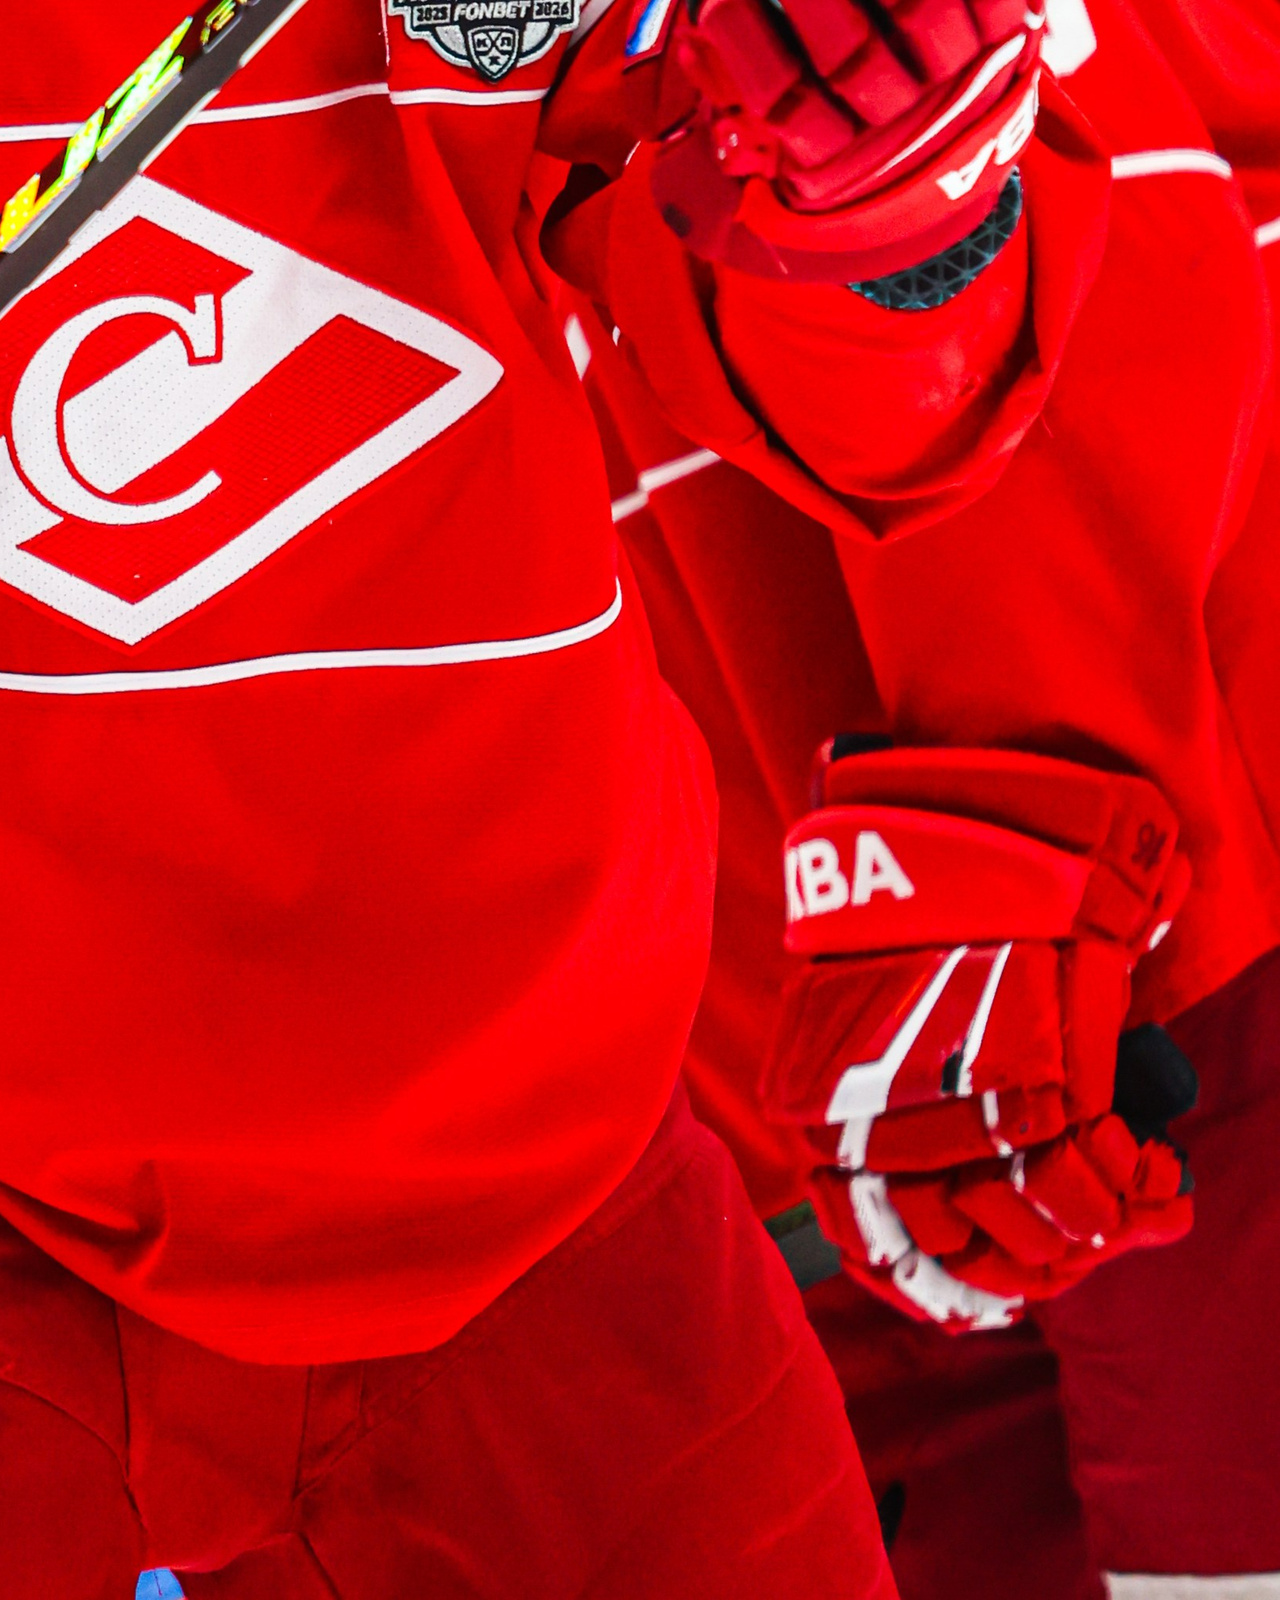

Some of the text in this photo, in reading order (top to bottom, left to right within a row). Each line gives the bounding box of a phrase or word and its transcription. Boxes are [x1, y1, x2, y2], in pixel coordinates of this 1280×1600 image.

[416, 0, 570, 22] 2025 FONBET 2026
